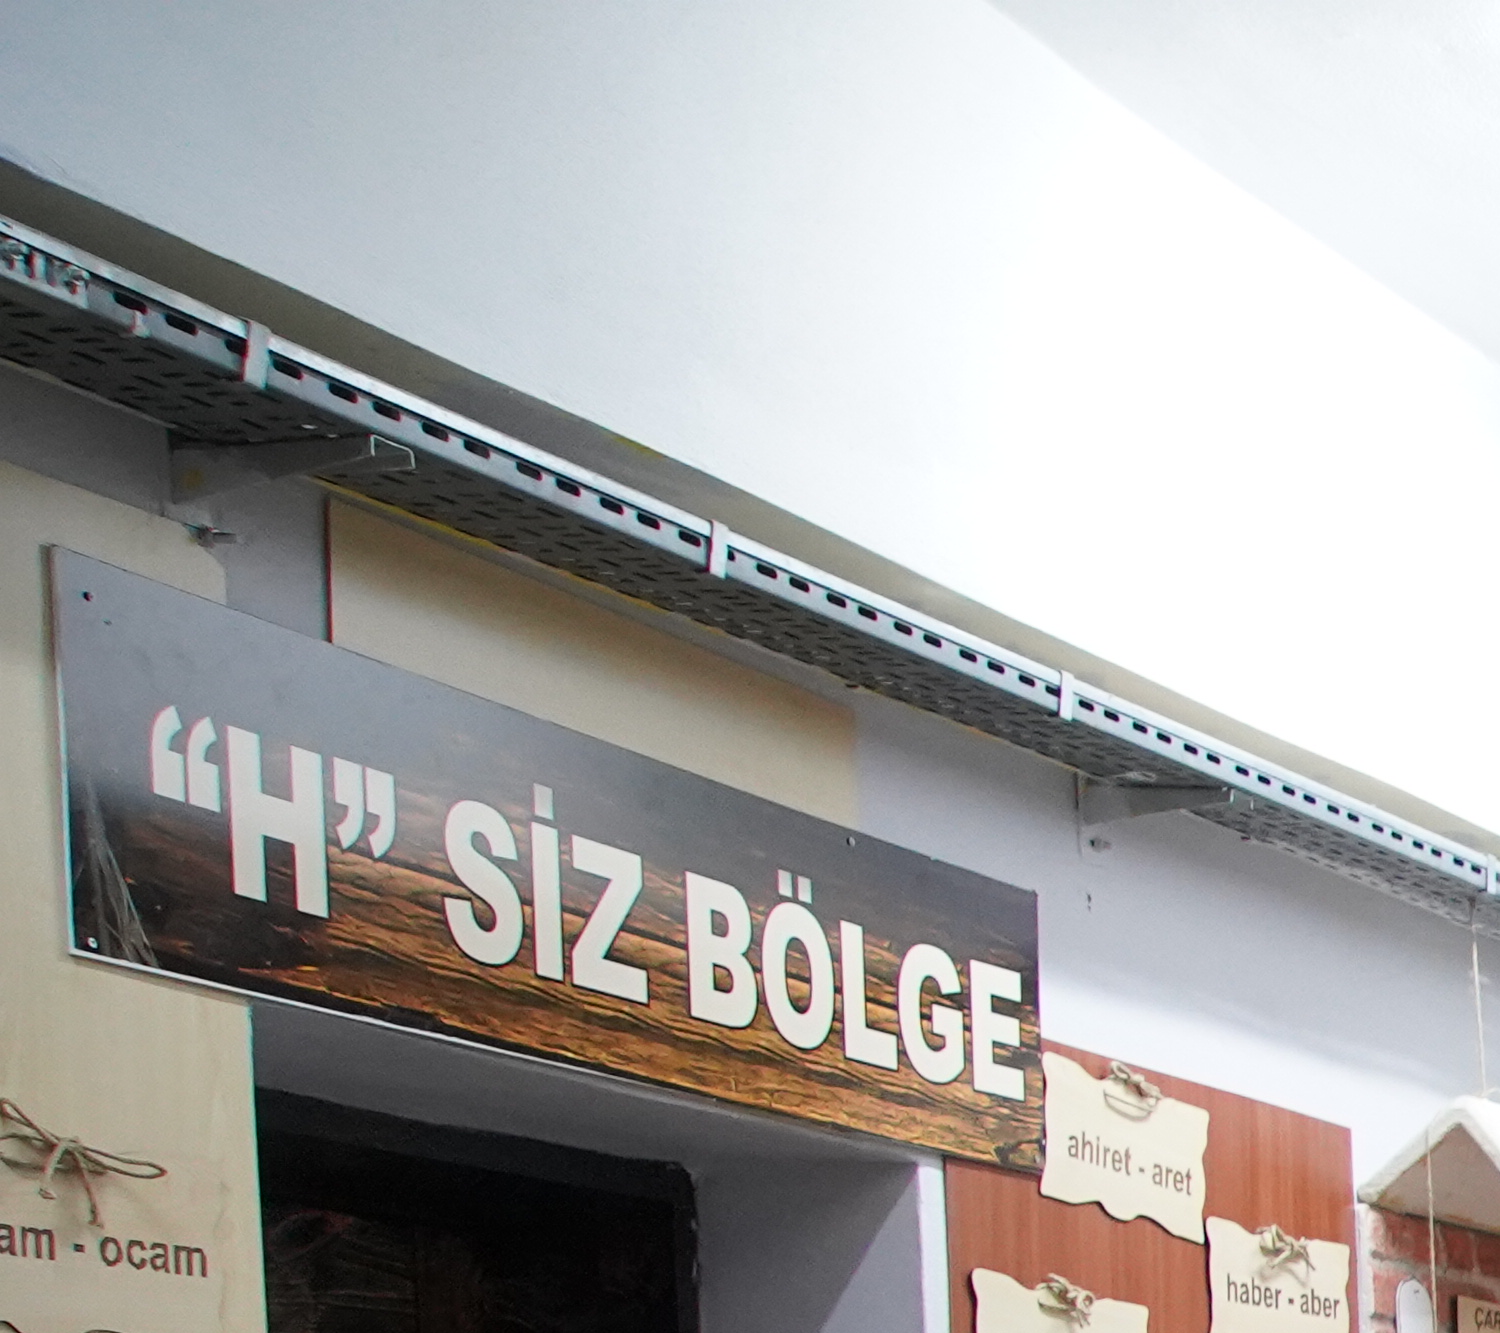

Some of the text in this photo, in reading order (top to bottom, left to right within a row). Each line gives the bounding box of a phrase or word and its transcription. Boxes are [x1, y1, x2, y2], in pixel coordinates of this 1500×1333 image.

[442, 782, 650, 1006] SİZ
[685, 869, 1027, 1102] BÖLGE
[1067, 1132, 1193, 1197] ahiret aret
[100, 1235, 209, 1278] ocam
[1226, 1273, 1341, 1320] haber aber
